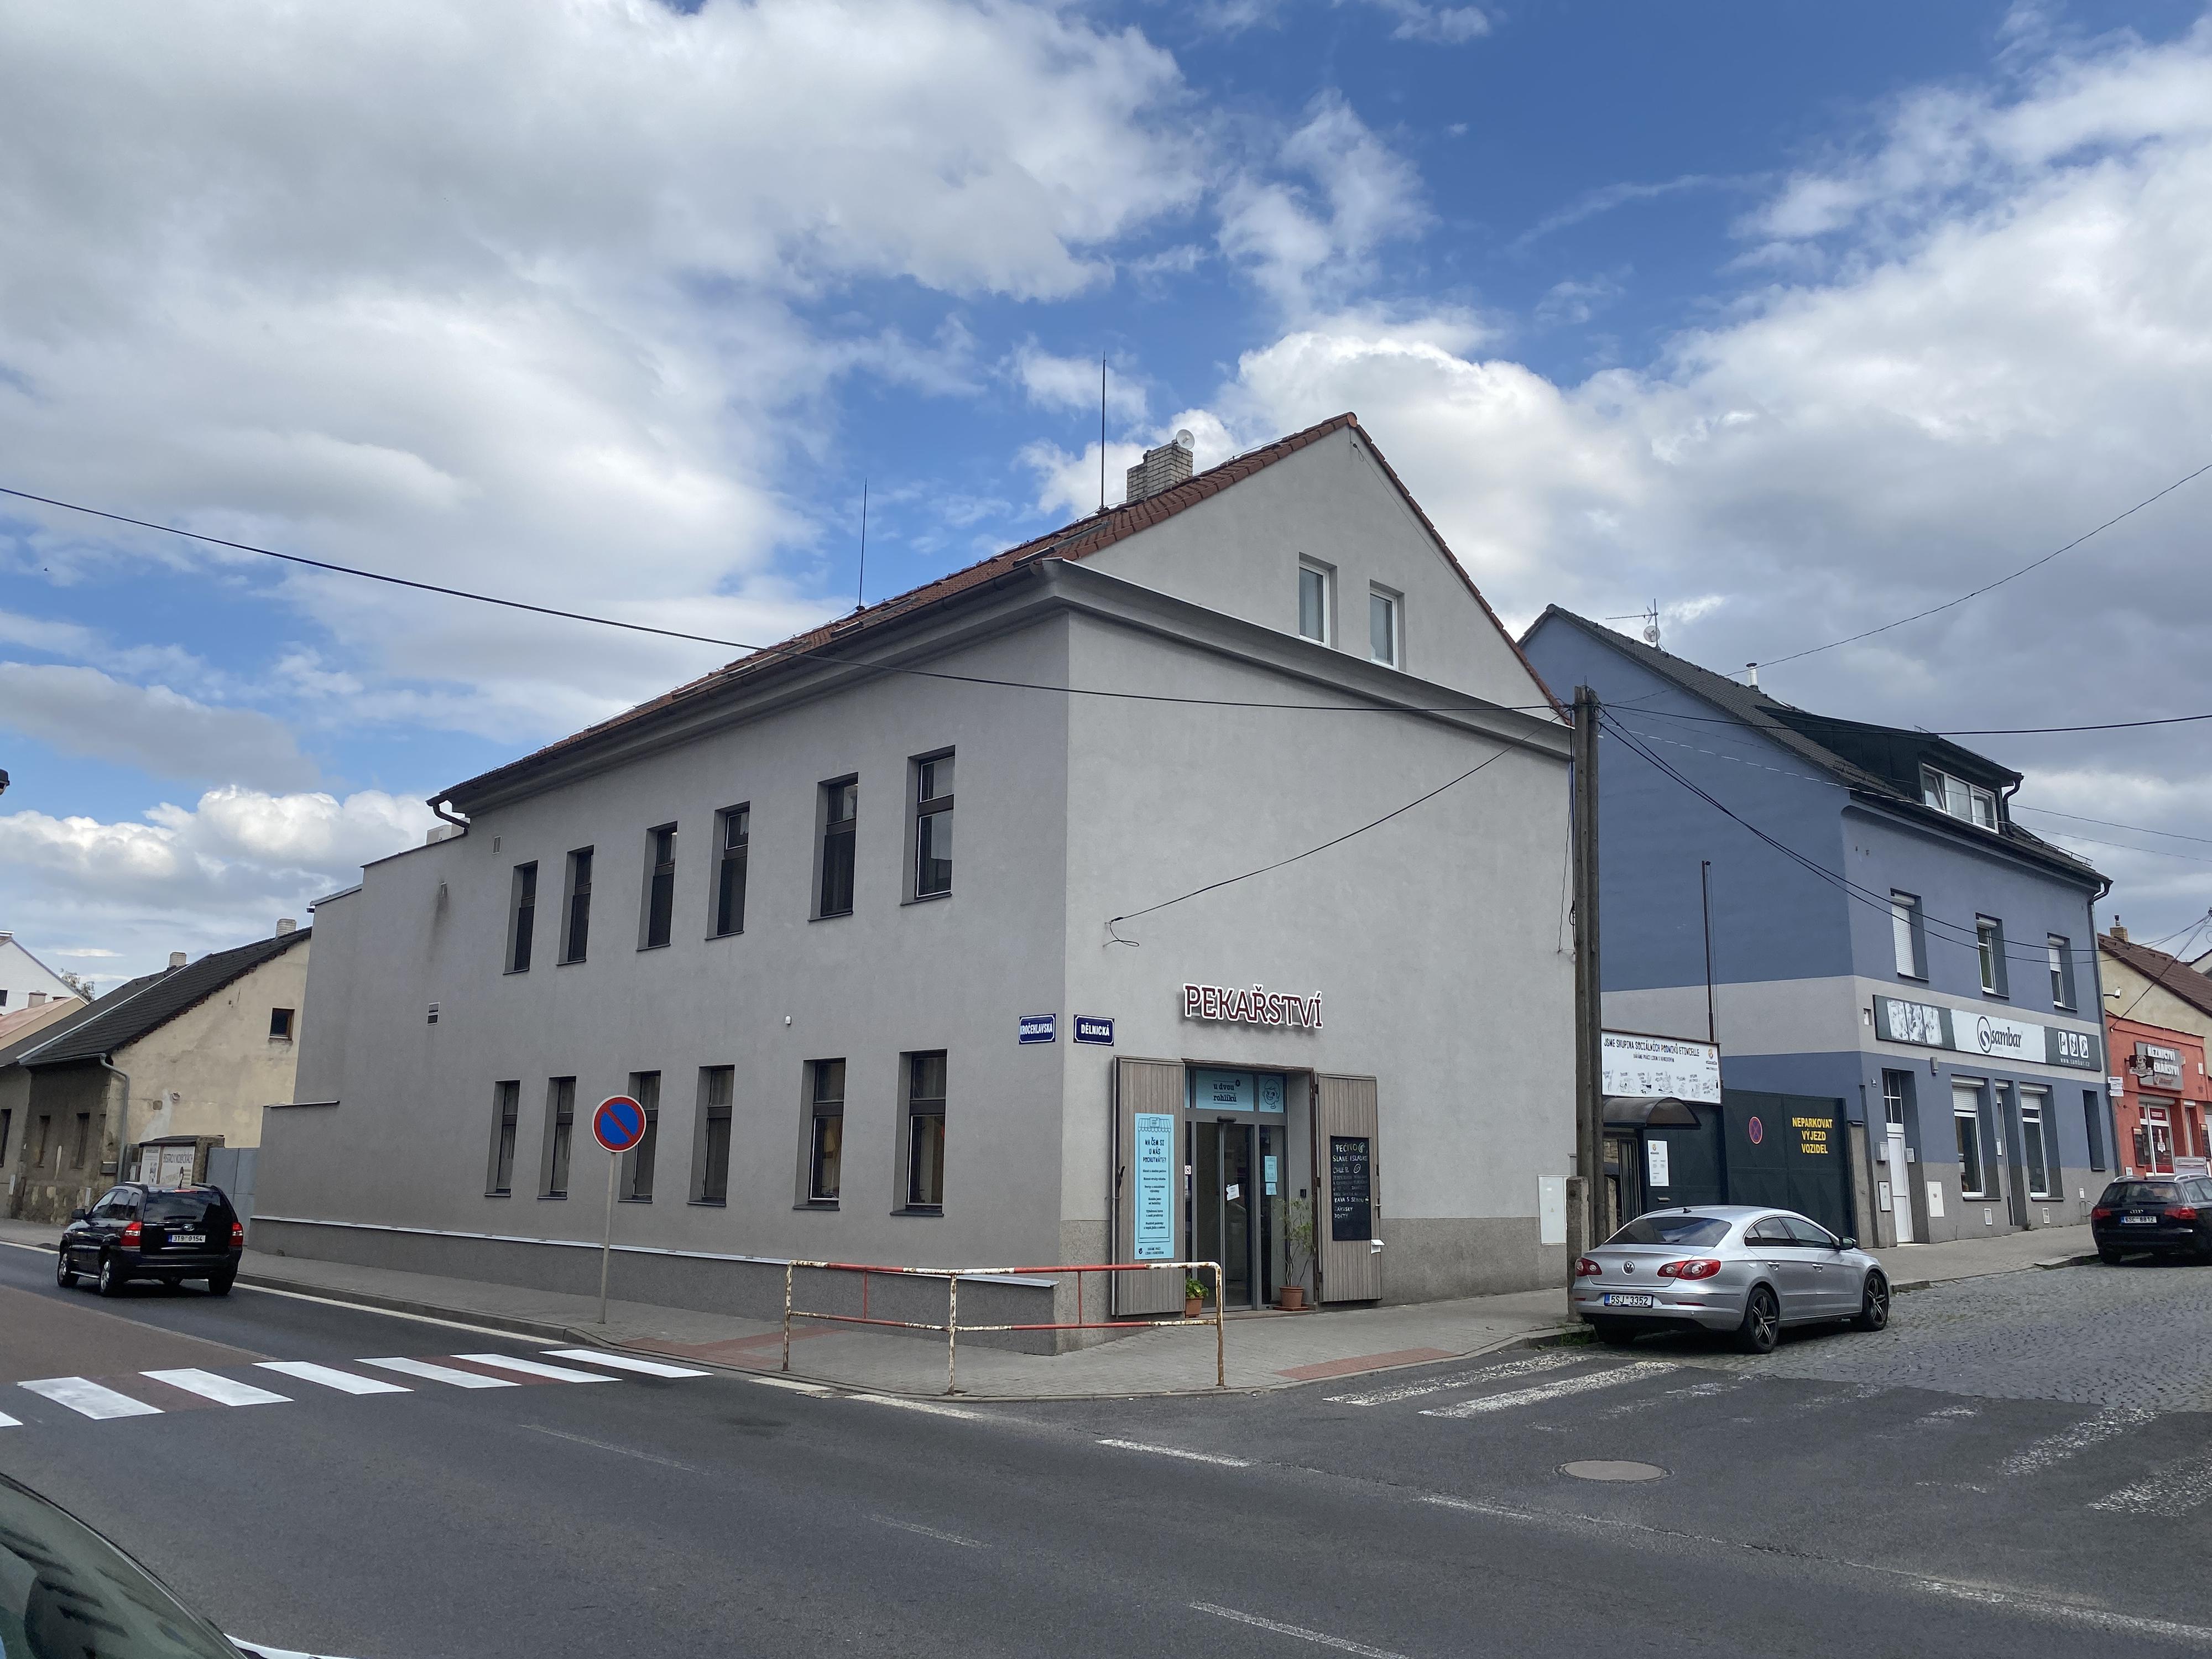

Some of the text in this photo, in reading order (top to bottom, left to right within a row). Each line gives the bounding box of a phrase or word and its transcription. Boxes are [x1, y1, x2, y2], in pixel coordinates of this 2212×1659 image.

[1183, 983, 1323, 1029] PEKAŘSTVÍ
[1020, 1021, 1053, 1035] KROČEHLAVSKÁ
[1081, 1022, 1110, 1036] DĚLNICKÁ
[1991, 1026, 2022, 1048] sambar
[1604, 1038, 1615, 1047] JSME
[1616, 1039, 1634, 1049] SKUPINA
[1635, 1040, 1660, 1052] SOCIÁLNÍCH
[1679, 1047, 1699, 1057] ETINCELLE
[1213, 1093, 1237, 1102] rohlíků
[1792, 1117, 1833, 1129] NEPARKOVAT
[1801, 1128, 1826, 1141] VÝJEZD
[1152, 1146, 1161, 1155] NÁS
[1335, 1142, 1358, 1152] PEČIVO
[1801, 1143, 1828, 1154] VOZIDEL
[1611, 1295, 1648, 1305] 5SJ 3352
